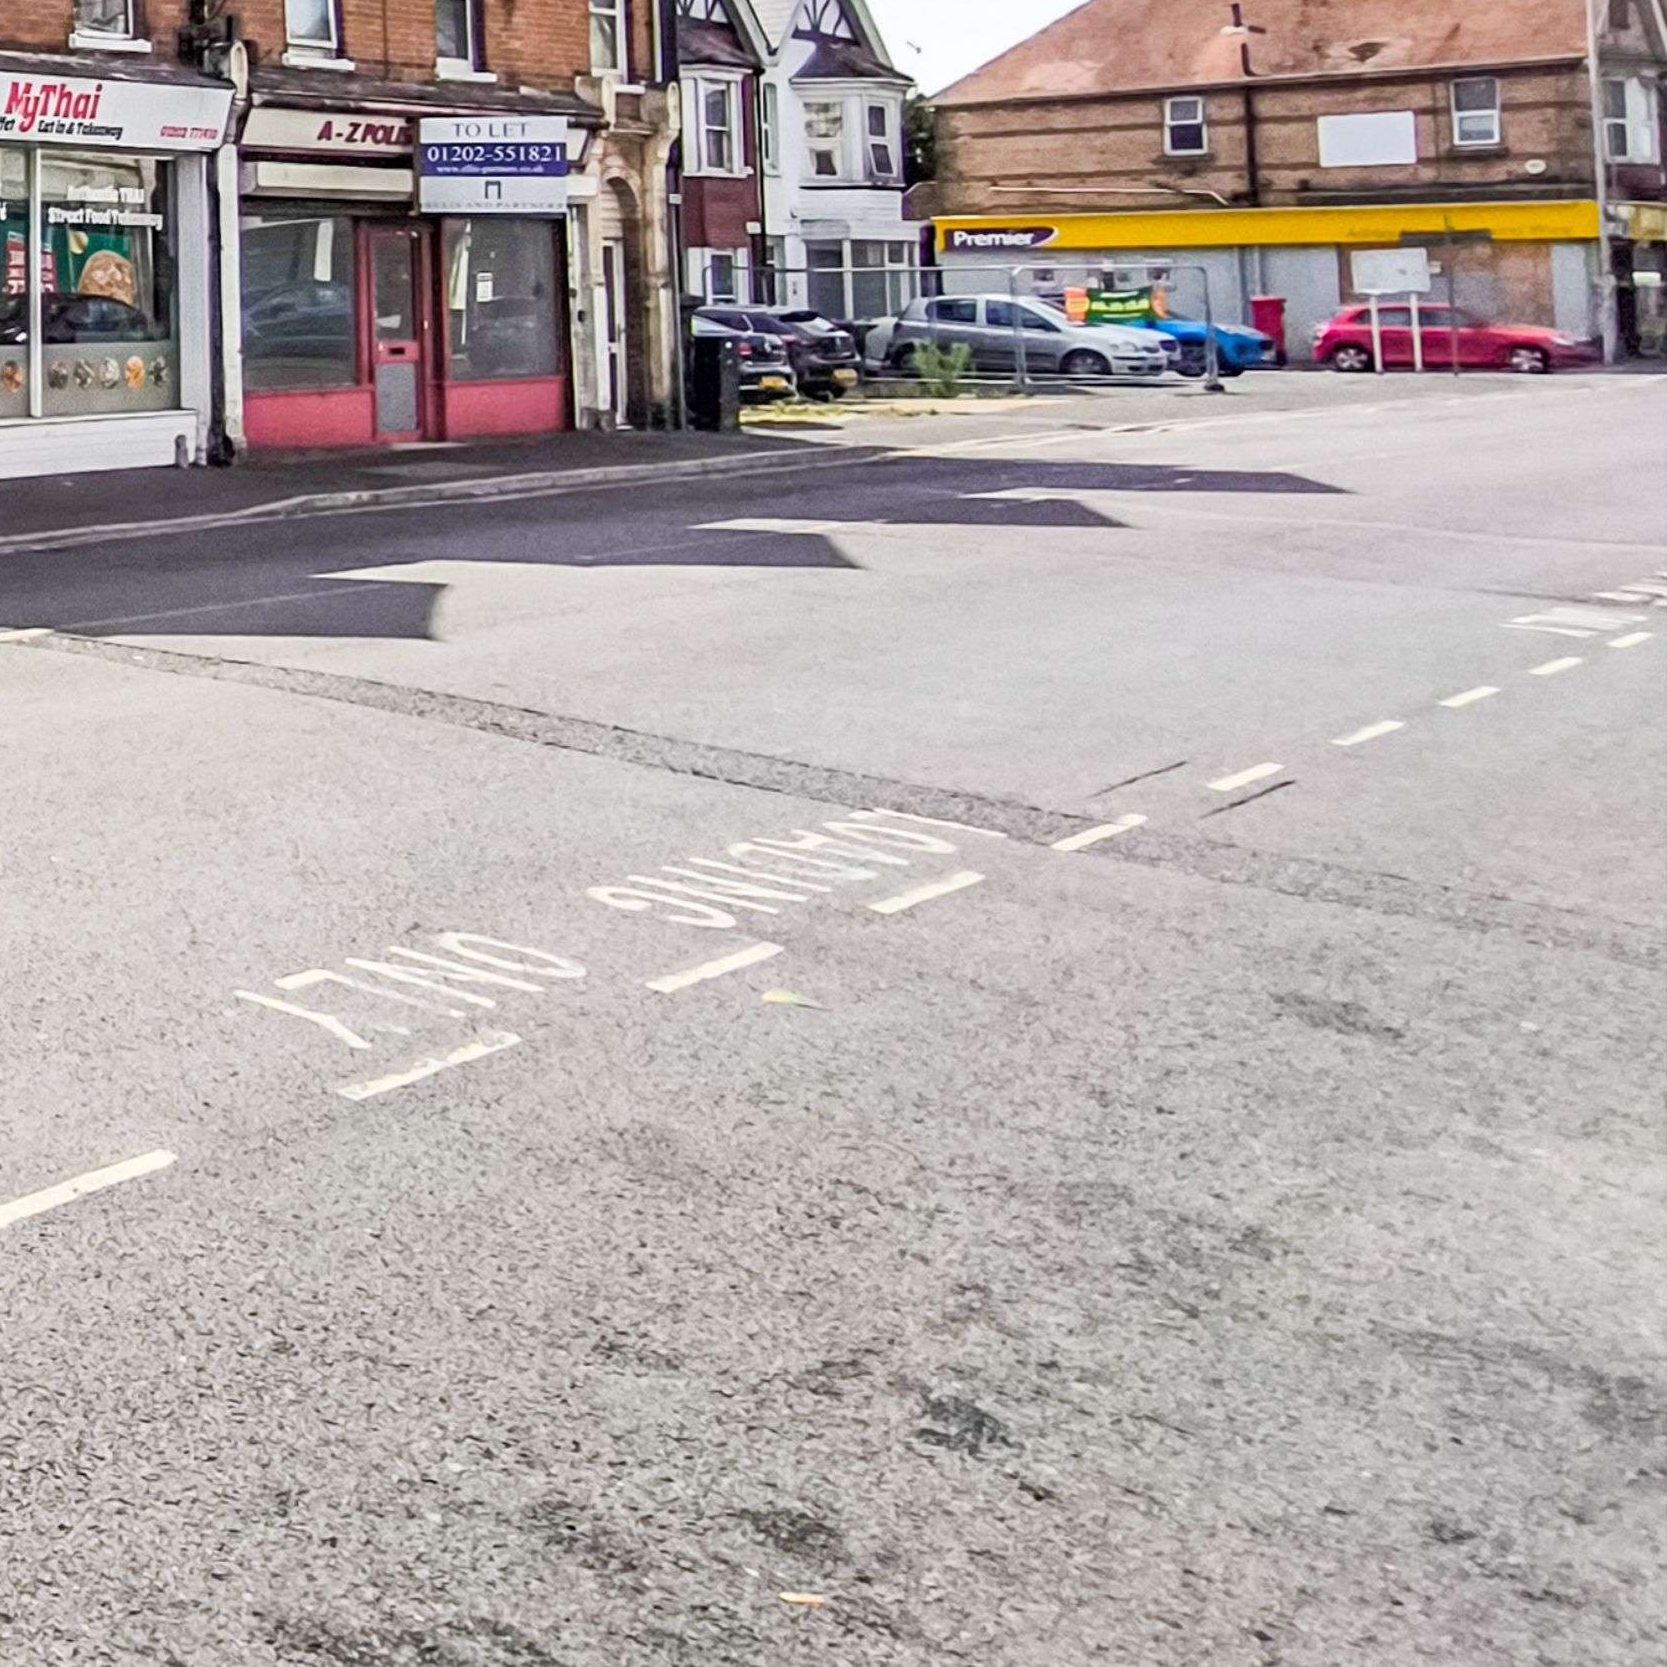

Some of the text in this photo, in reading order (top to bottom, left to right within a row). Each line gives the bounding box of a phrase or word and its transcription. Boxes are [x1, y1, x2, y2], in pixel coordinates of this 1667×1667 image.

[4, 81, 104, 132] MyThai
[453, 122, 530, 138] TO LET
[426, 145, 562, 163] 01202-551821
[953, 230, 1035, 246] Premier
